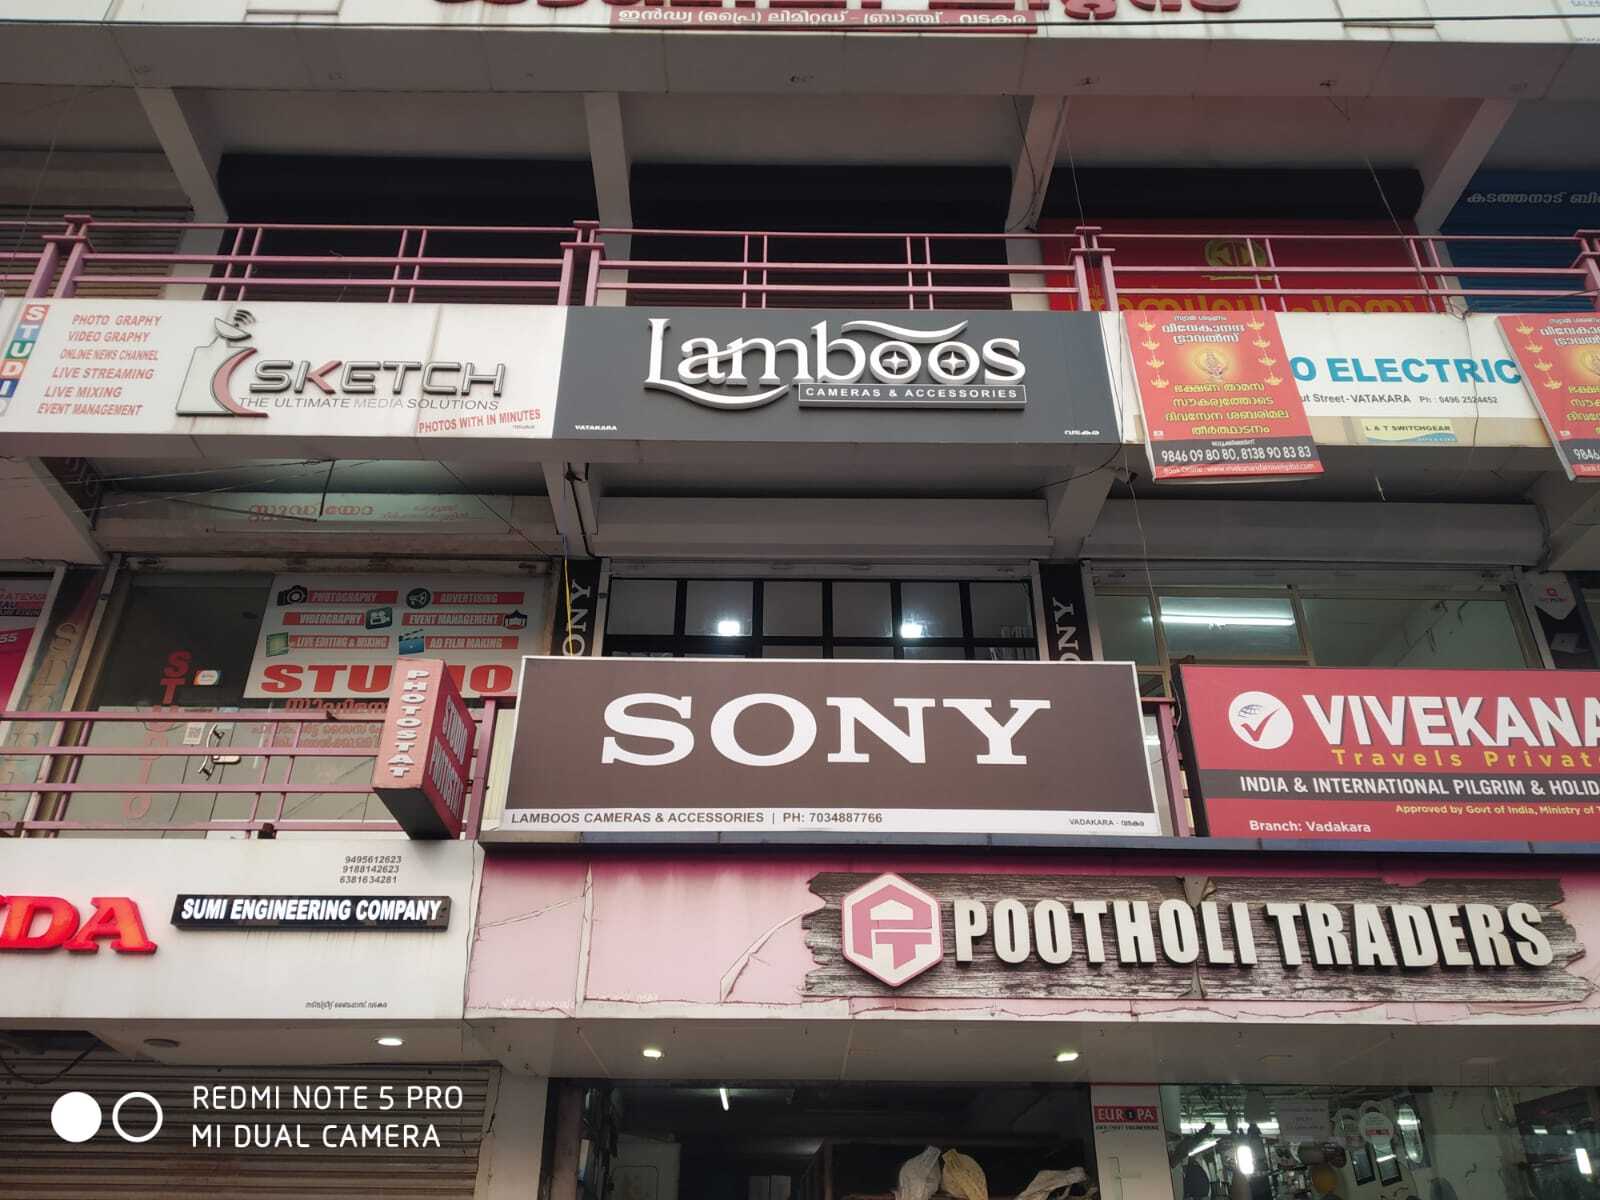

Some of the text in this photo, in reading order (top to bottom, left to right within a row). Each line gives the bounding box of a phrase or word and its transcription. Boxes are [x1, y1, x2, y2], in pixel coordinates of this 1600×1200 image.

[72, 314, 161, 326] PHOTO GRAPHY
[68, 331, 151, 343] VIDEO GRAPHY
[60, 349, 159, 361] ONLINE NEWS CHANNEL
[643, 317, 1027, 410] Lamboos
[1327, 357, 1522, 384] ELECTRIC
[52, 367, 154, 380] LIVE STREAMING
[250, 360, 506, 396] SKETCH
[44, 386, 122, 398] LIVE MIXING
[805, 387, 1018, 399] CAMERAS & ACCESSORIES
[37, 402, 143, 416] EVENT MANAGEMENT
[239, 397, 500, 411] THE ULTIMATE MEDIA SOLUTIONS
[418, 408, 542, 434] PHOTOS WITH IN MINUTES
[1161, 450, 1188, 463] 9846
[1189, 449, 1204, 462] 09
[1205, 448, 1221, 461] 80
[1241, 447, 1266, 460] 8138
[1267, 446, 1282, 459] 90
[1283, 446, 1296, 458] 83
[1297, 445, 1312, 458] 83
[311, 592, 377, 603] PHOTOGRAPHY
[299, 613, 499, 625] VIDEOGRAPHY EVENT MANAGEMENT
[562, 577, 591, 656] ONY
[1052, 596, 1080, 661] NY
[296, 636, 315, 648] LIVE
[315, 636, 348, 648] EDITING
[356, 637, 387, 649] MIXING
[430, 637, 444, 649] AD
[445, 637, 465, 649] FILM
[466, 637, 502, 649] MAKING
[261, 664, 514, 693] STUO
[387, 669, 430, 778] PHOTOSTAT
[1302, 694, 1600, 748] VIVEKANA
[601, 693, 1051, 767] SONY
[1332, 748, 1600, 768] Travels Privat
[1240, 775, 1600, 797] INDIA & INTERNATIONAL PILGRIM & HOLID
[1395, 804, 1447, 816] Approved
[1449, 804, 1463, 816] by
[1466, 804, 1492, 815] Govt
[1494, 804, 1506, 815] of
[1508, 805, 1538, 817] India,
[1540, 805, 1581, 817] Ministry
[1583, 806, 1595, 815] of
[511, 812, 581, 825] LAMBOOS
[583, 812, 652, 824] CAMERAS
[655, 813, 664, 824] &
[668, 812, 765, 824] ACCESSORIES
[783, 812, 806, 824] PH:
[809, 812, 883, 824] 7034887766
[1069, 817, 1114, 826] VADAKARA
[1249, 819, 1371, 834] Branch: Vadakara
[345, 855, 402, 864] 9495612623
[181, 898, 442, 921] SUMI ENGINEERING COMPANY
[955, 898, 1556, 969] POOTHOLI TRADERS
